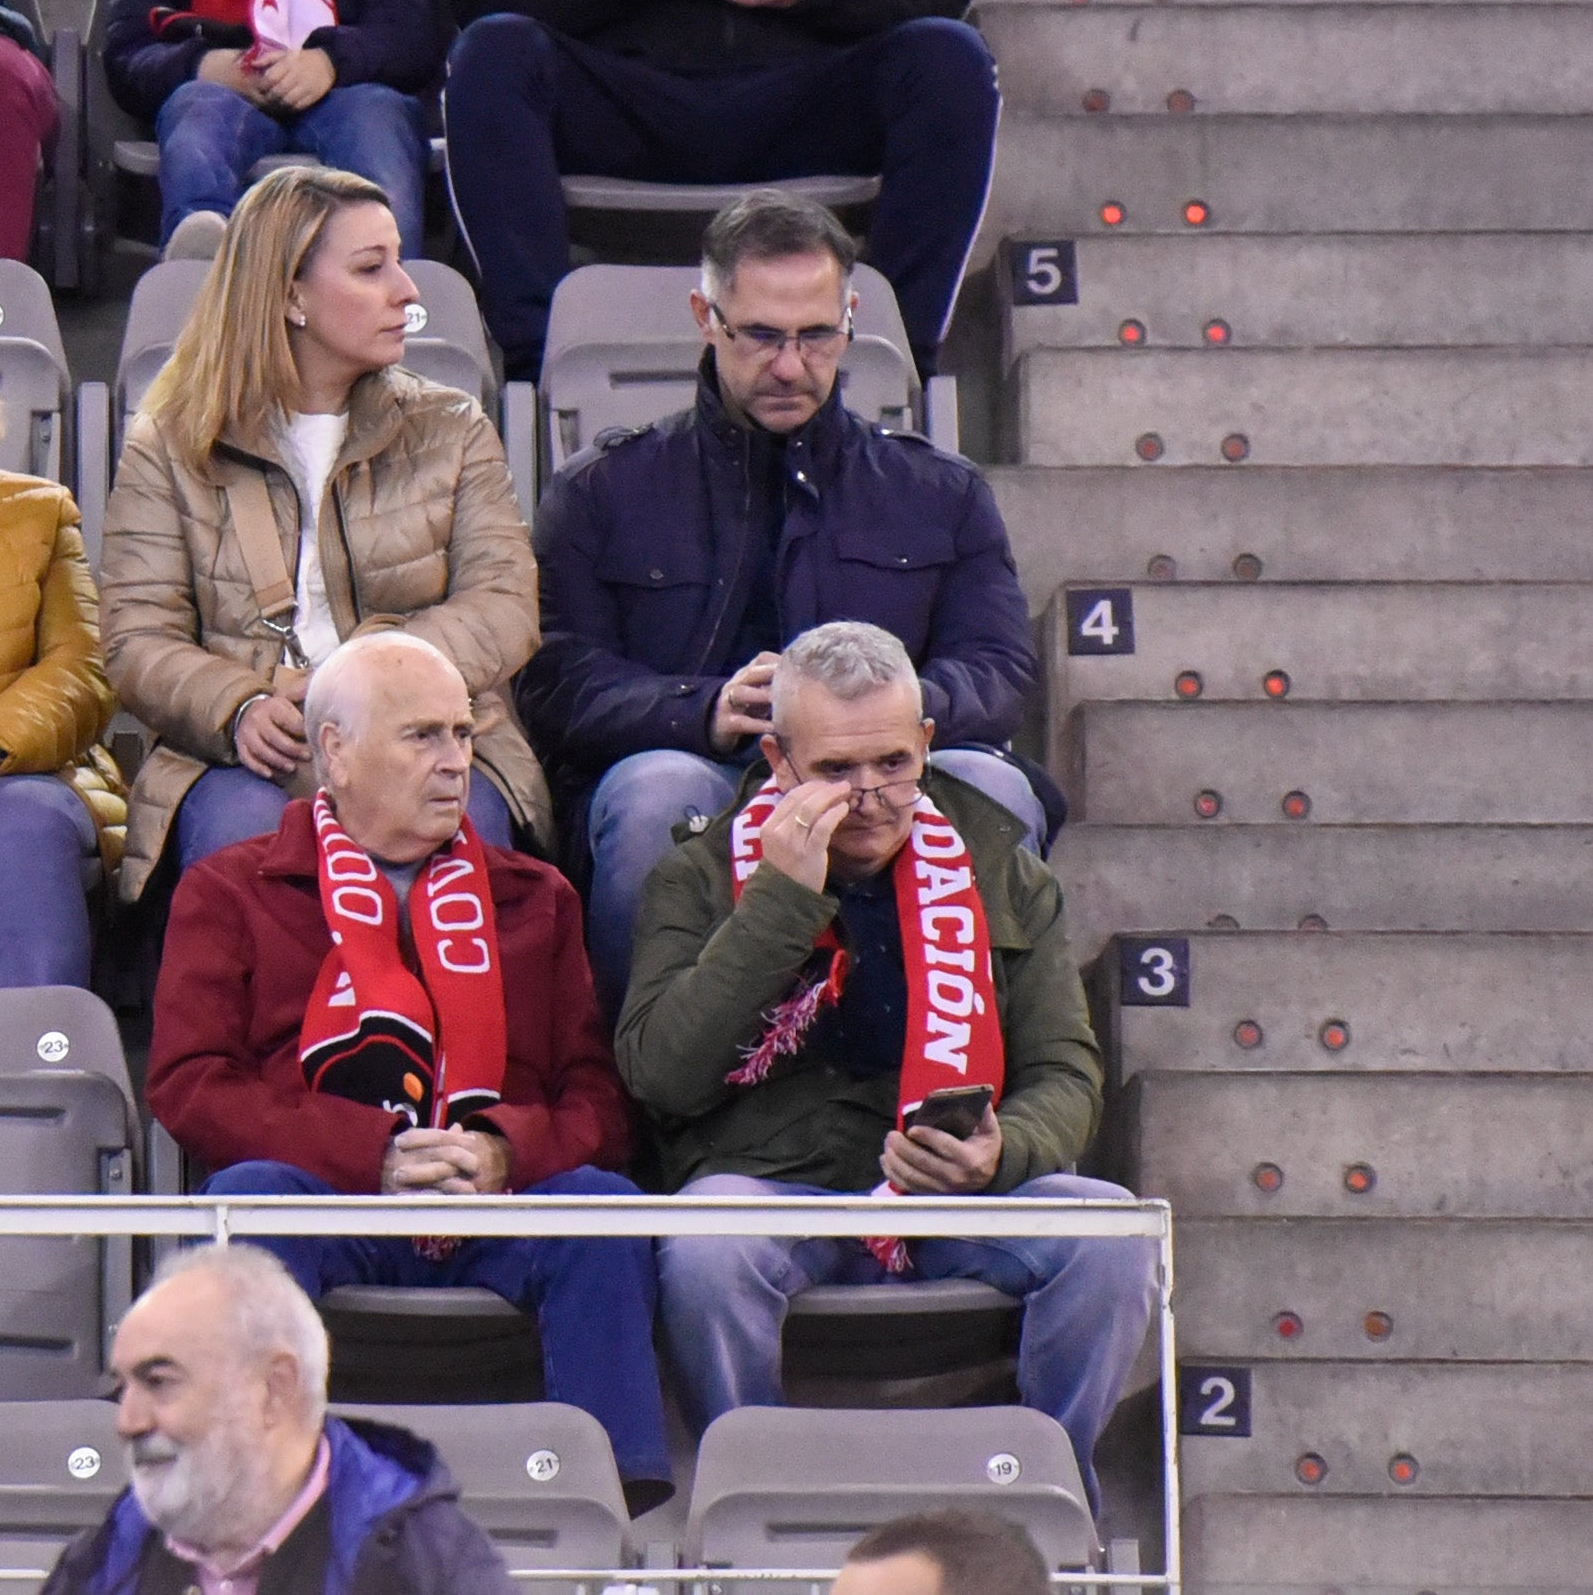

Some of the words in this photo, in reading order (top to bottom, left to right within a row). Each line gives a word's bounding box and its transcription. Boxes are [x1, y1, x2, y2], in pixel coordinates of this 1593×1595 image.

[1027, 248, 1062, 294] 5
[1081, 599, 1119, 644] 4
[426, 830, 490, 974] COV
[910, 817, 985, 1077] DACIÓN
[1138, 949, 1175, 995] 3
[44, 1040, 63, 1054] 23
[1200, 1378, 1236, 1425] 2
[74, 1456, 95, 1470] 23
[535, 1458, 553, 1473] 21
[996, 1461, 1013, 1476] 19
